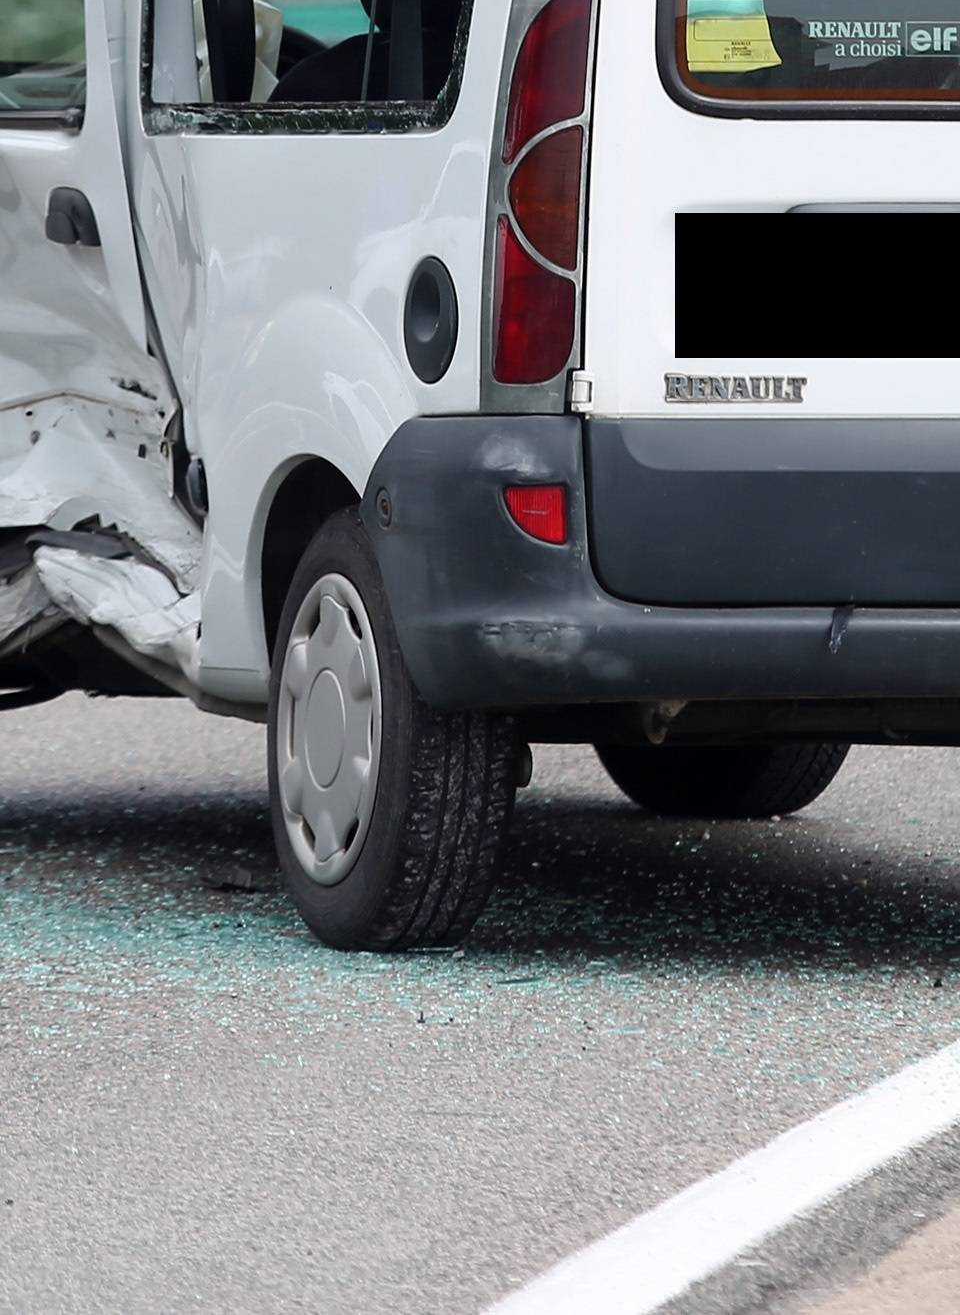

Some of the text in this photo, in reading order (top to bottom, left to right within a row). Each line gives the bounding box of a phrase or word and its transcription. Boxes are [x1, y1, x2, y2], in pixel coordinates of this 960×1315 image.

[808, 21, 901, 38] RENAULT
[910, 27, 957, 52] elf
[835, 40, 901, 57] a choisi
[664, 373, 807, 403] RENAULT
